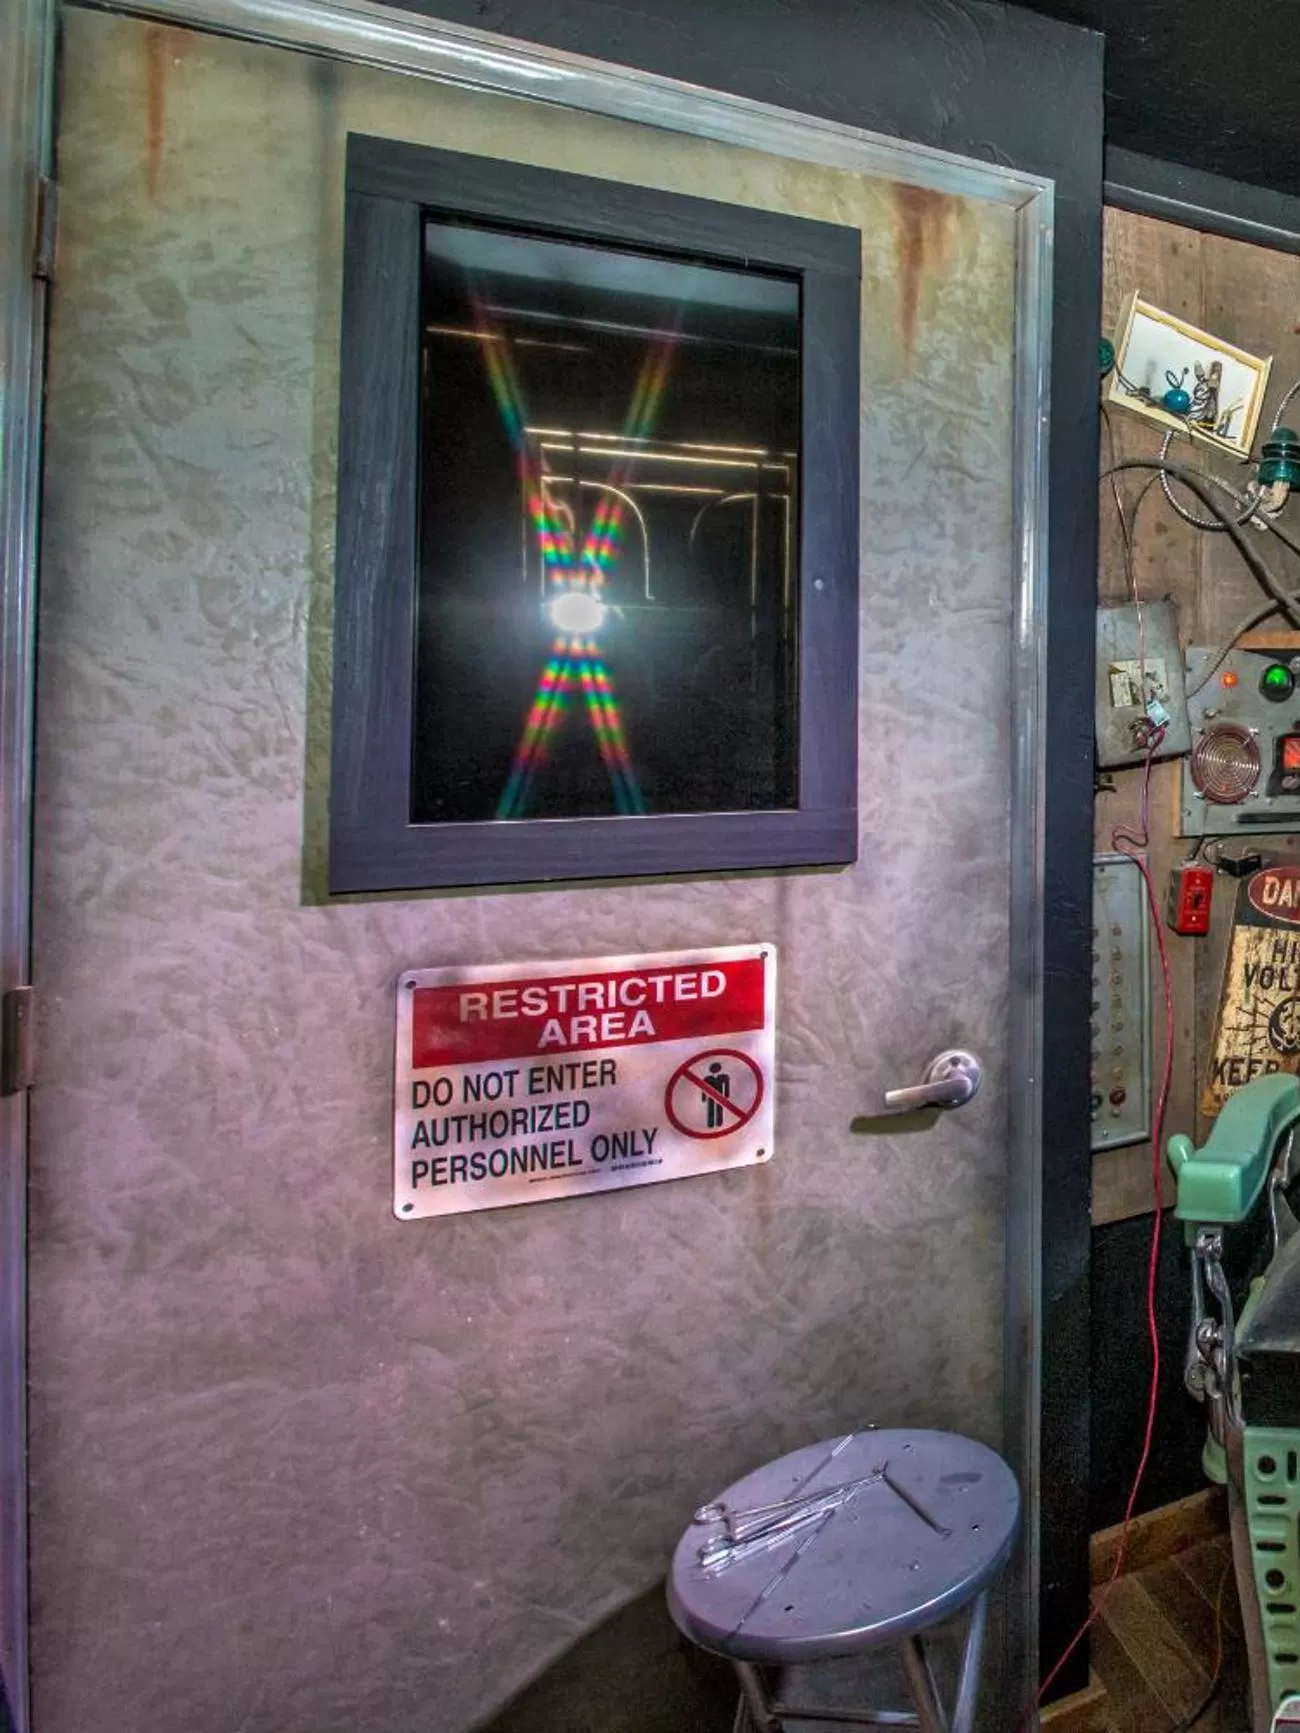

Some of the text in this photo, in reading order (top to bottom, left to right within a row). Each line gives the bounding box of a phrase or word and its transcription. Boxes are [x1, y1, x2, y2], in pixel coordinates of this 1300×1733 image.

[459, 969, 727, 1023] RESTRICTED
[537, 1009, 656, 1050] AREA
[411, 1058, 617, 1110] DO NOT ENTER
[410, 1100, 590, 1149] AUTHORIZED
[411, 1141, 583, 1189] PERSONNEL
[590, 1127, 658, 1163] ONLY
